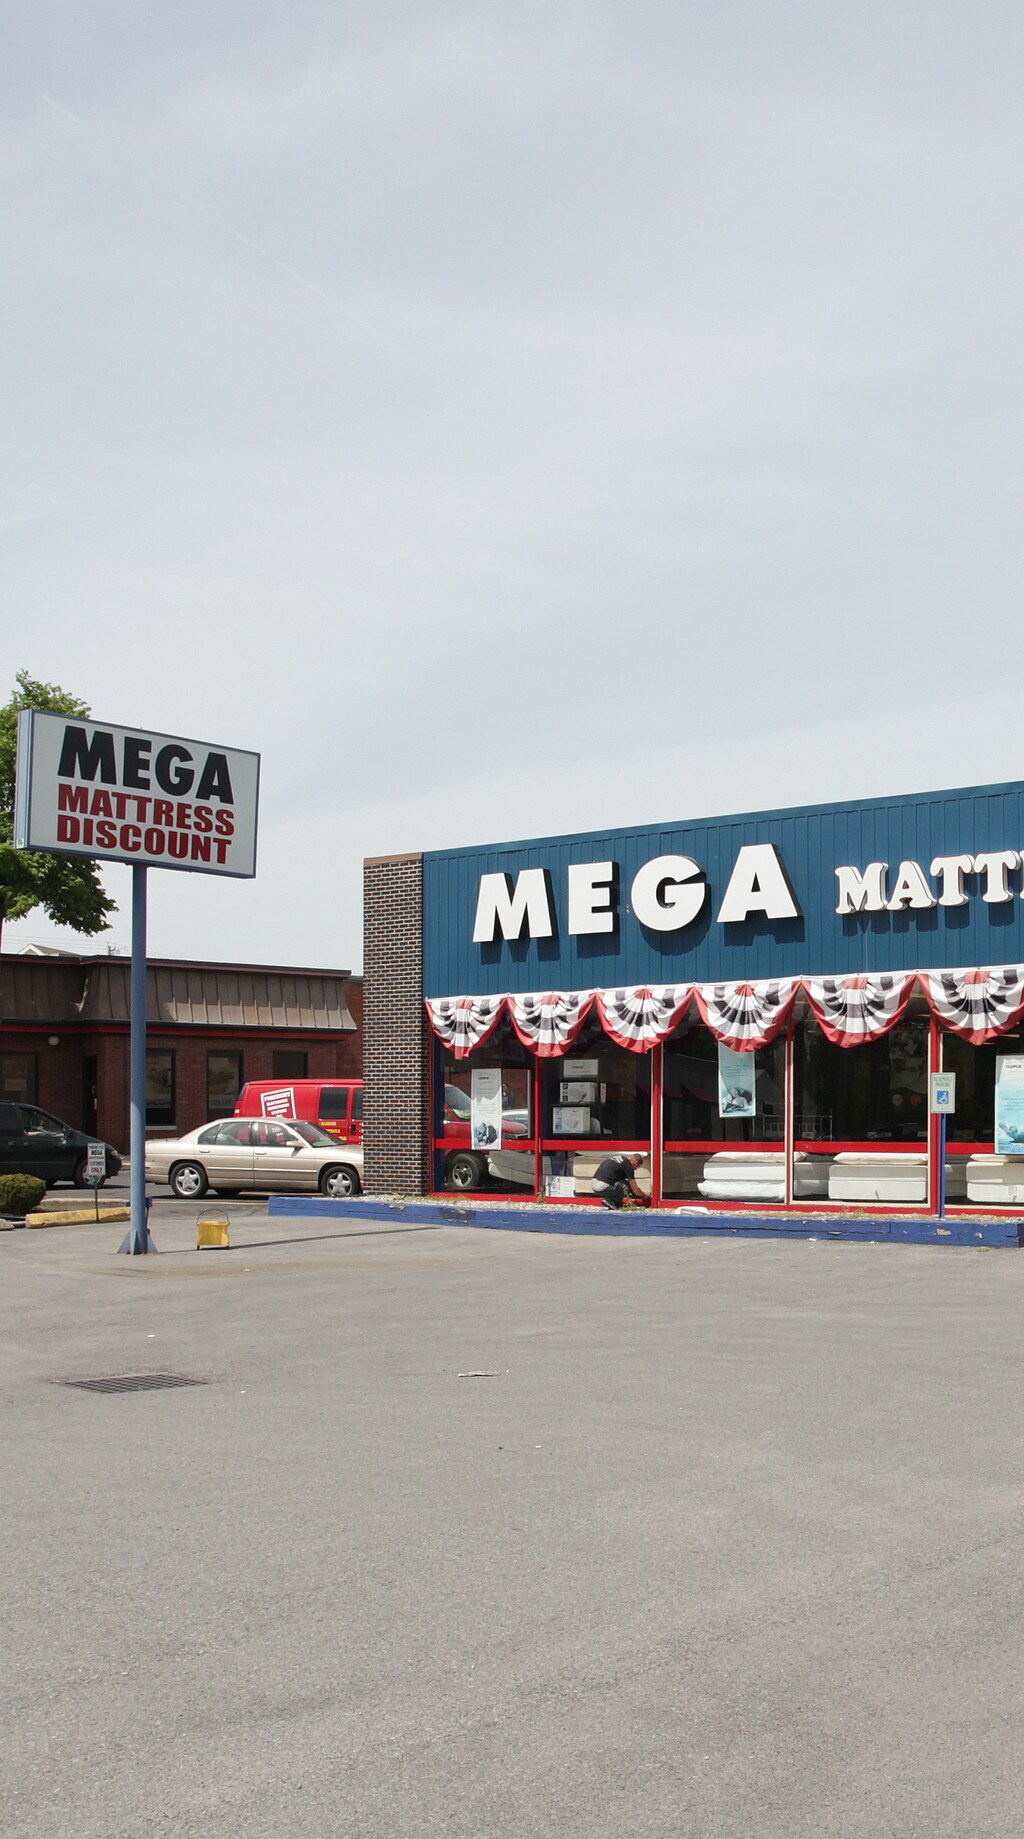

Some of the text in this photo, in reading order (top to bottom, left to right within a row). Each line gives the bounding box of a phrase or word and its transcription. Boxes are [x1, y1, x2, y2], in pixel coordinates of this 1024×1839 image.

[57, 725, 235, 805] MEGA
[56, 814, 232, 864] DISCOUNT
[57, 783, 235, 836] MATTRESS
[472, 843, 802, 942] MEGA
